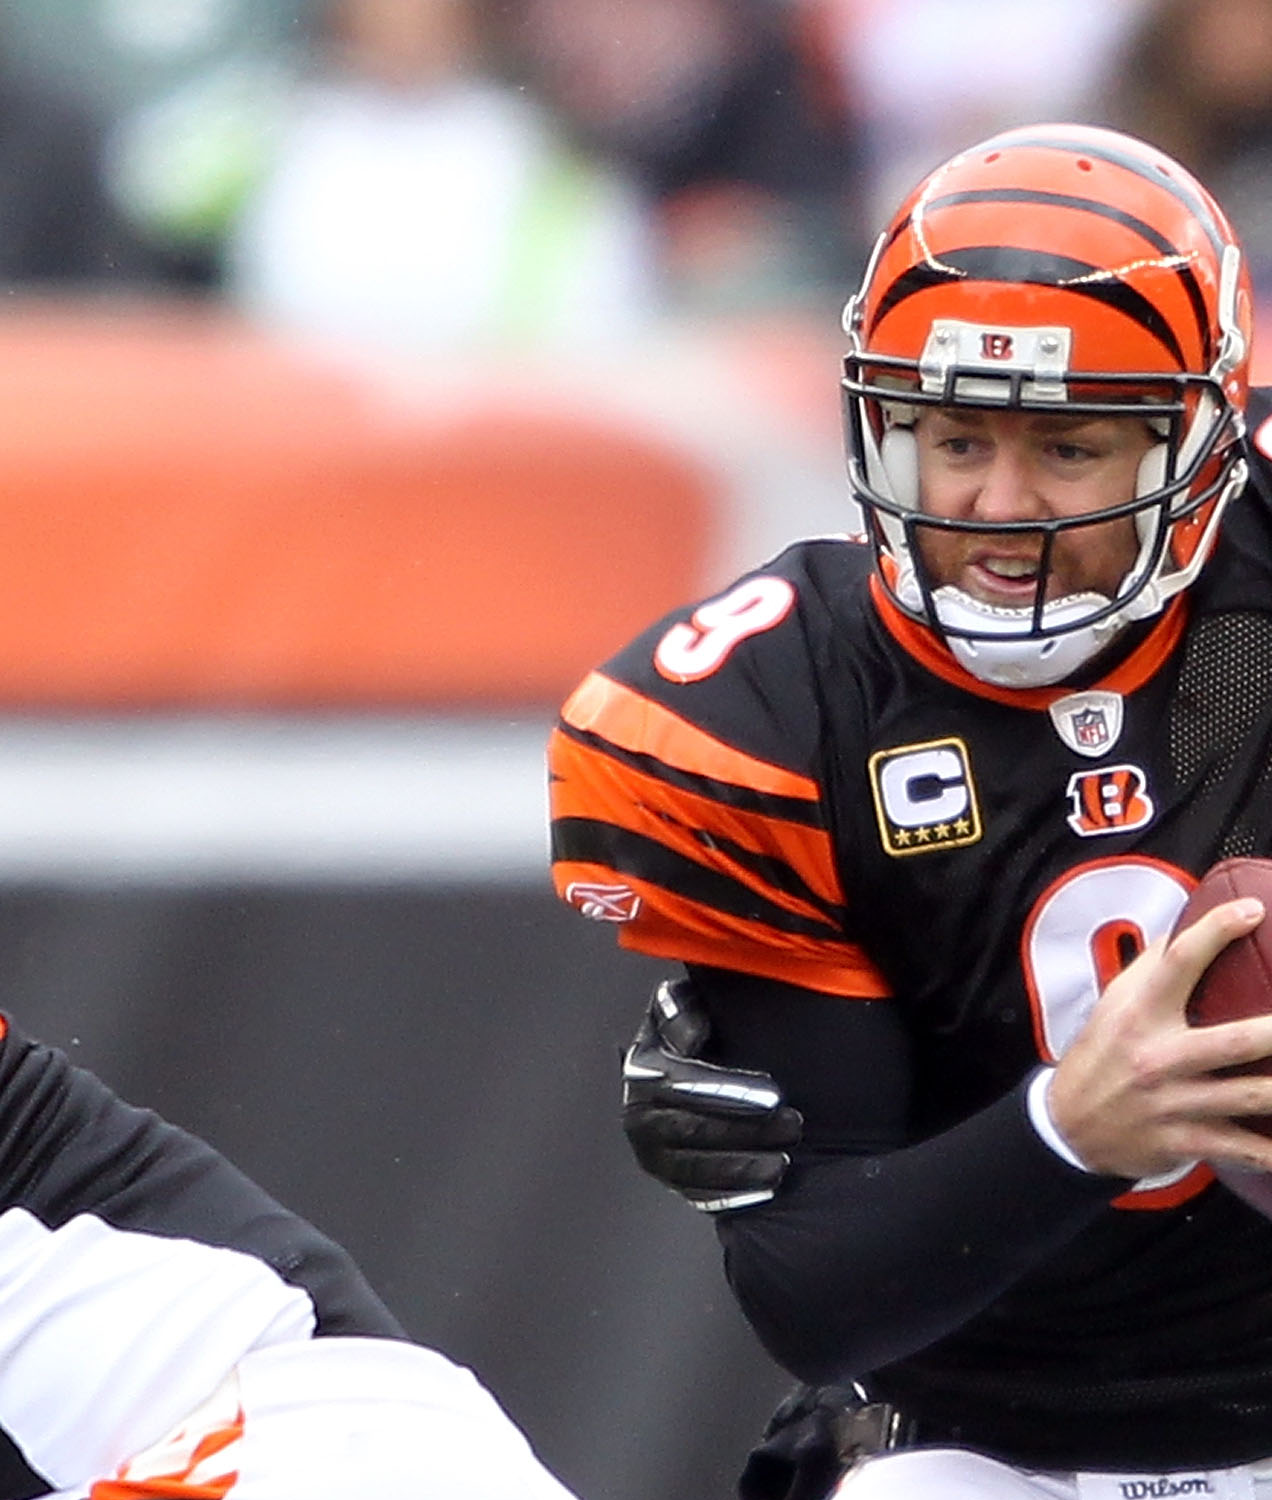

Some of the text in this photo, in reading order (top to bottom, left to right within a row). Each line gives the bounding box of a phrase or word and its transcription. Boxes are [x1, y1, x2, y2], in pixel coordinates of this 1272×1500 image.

[653, 576, 798, 684] 9
[881, 750, 967, 828] C
[1118, 1478, 1215, 1500] Wilson
